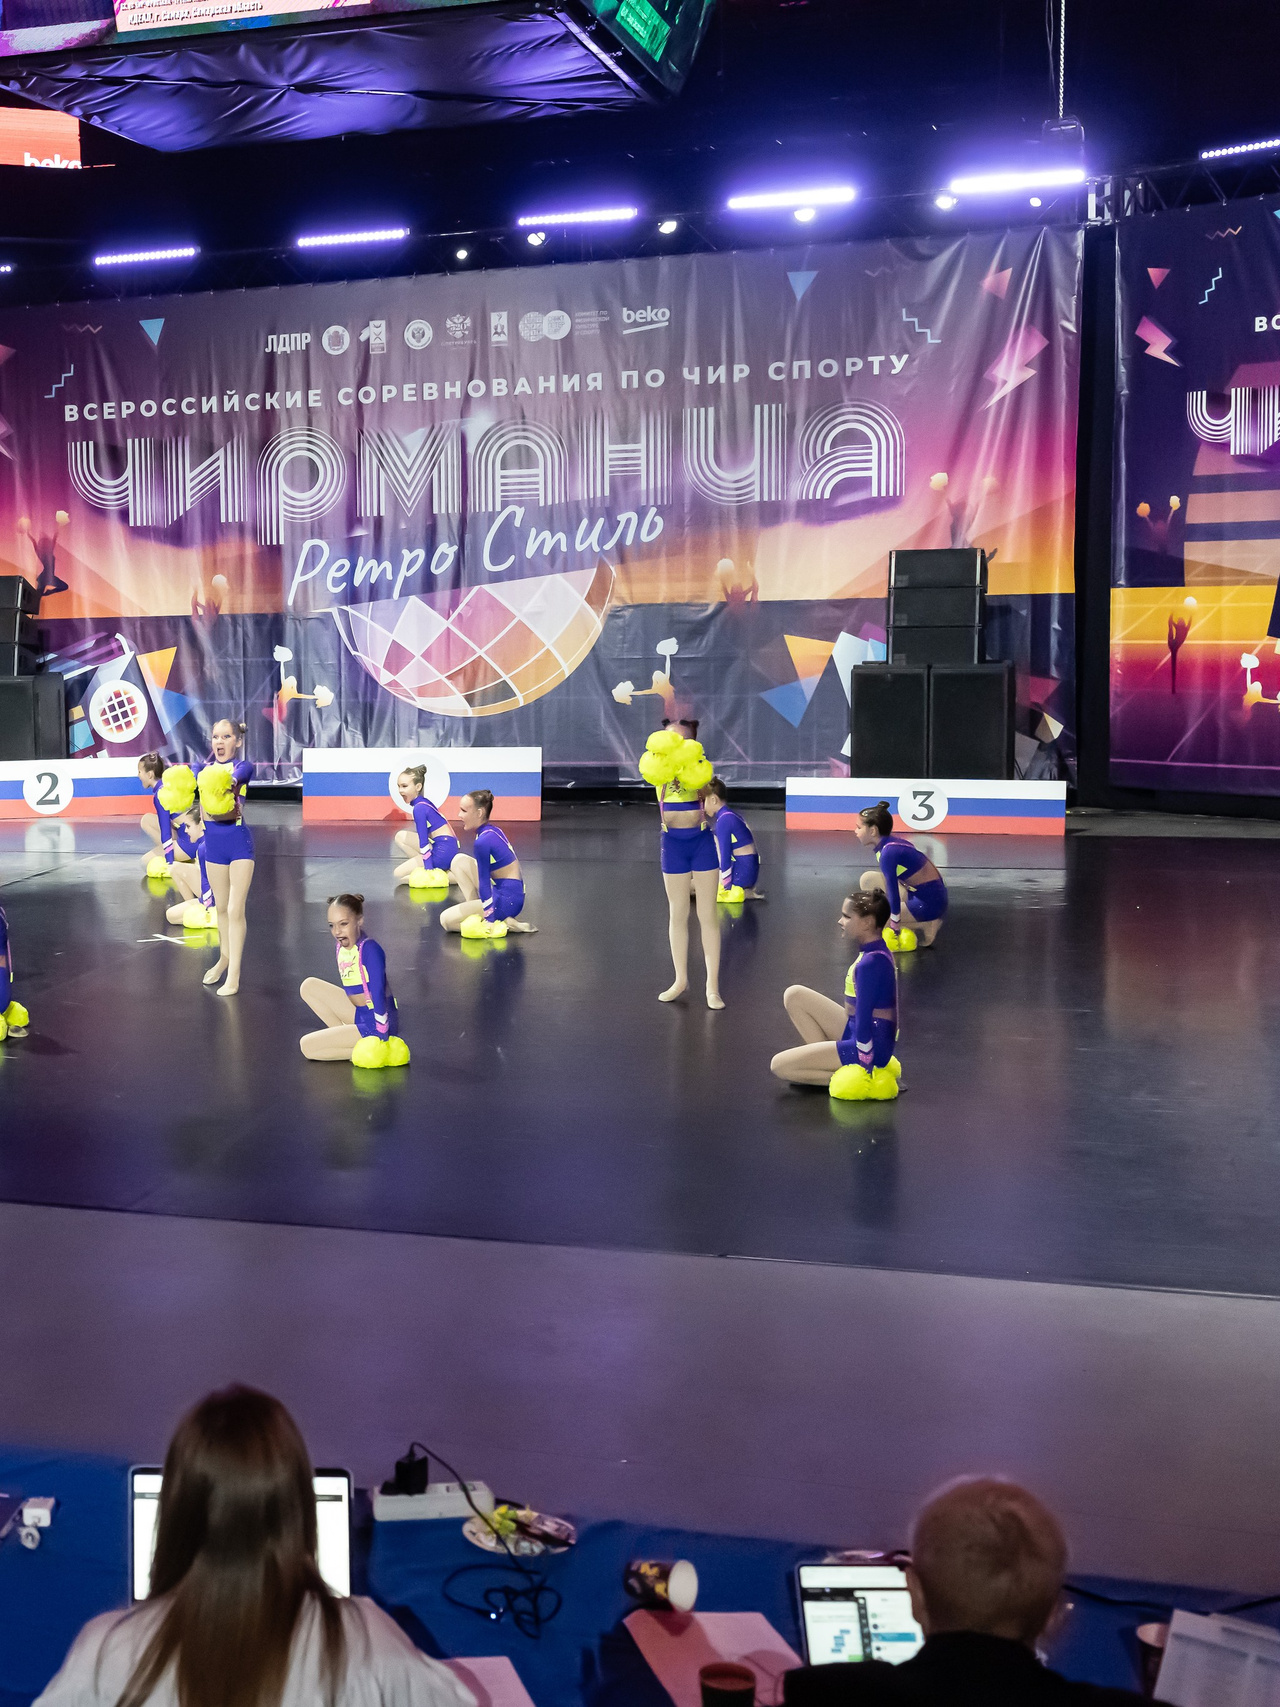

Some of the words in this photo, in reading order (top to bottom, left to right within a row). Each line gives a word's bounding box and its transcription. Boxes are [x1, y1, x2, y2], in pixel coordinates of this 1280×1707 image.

[622, 305, 671, 324] beko
[265, 332, 311, 354] ЛДПР
[64, 388, 322, 422] ВСЕРОССИЙСКИЕ
[337, 372, 603, 406] СОРЕВНОВАНИЯ
[621, 368, 666, 389] ПО
[683, 364, 750, 386] ЧИР
[767, 353, 910, 381] СПОРТУ
[287, 538, 457, 606] Ретро
[483, 504, 665, 573] Стиль
[36, 772, 60, 806] 2
[911, 790, 935, 821] 3
